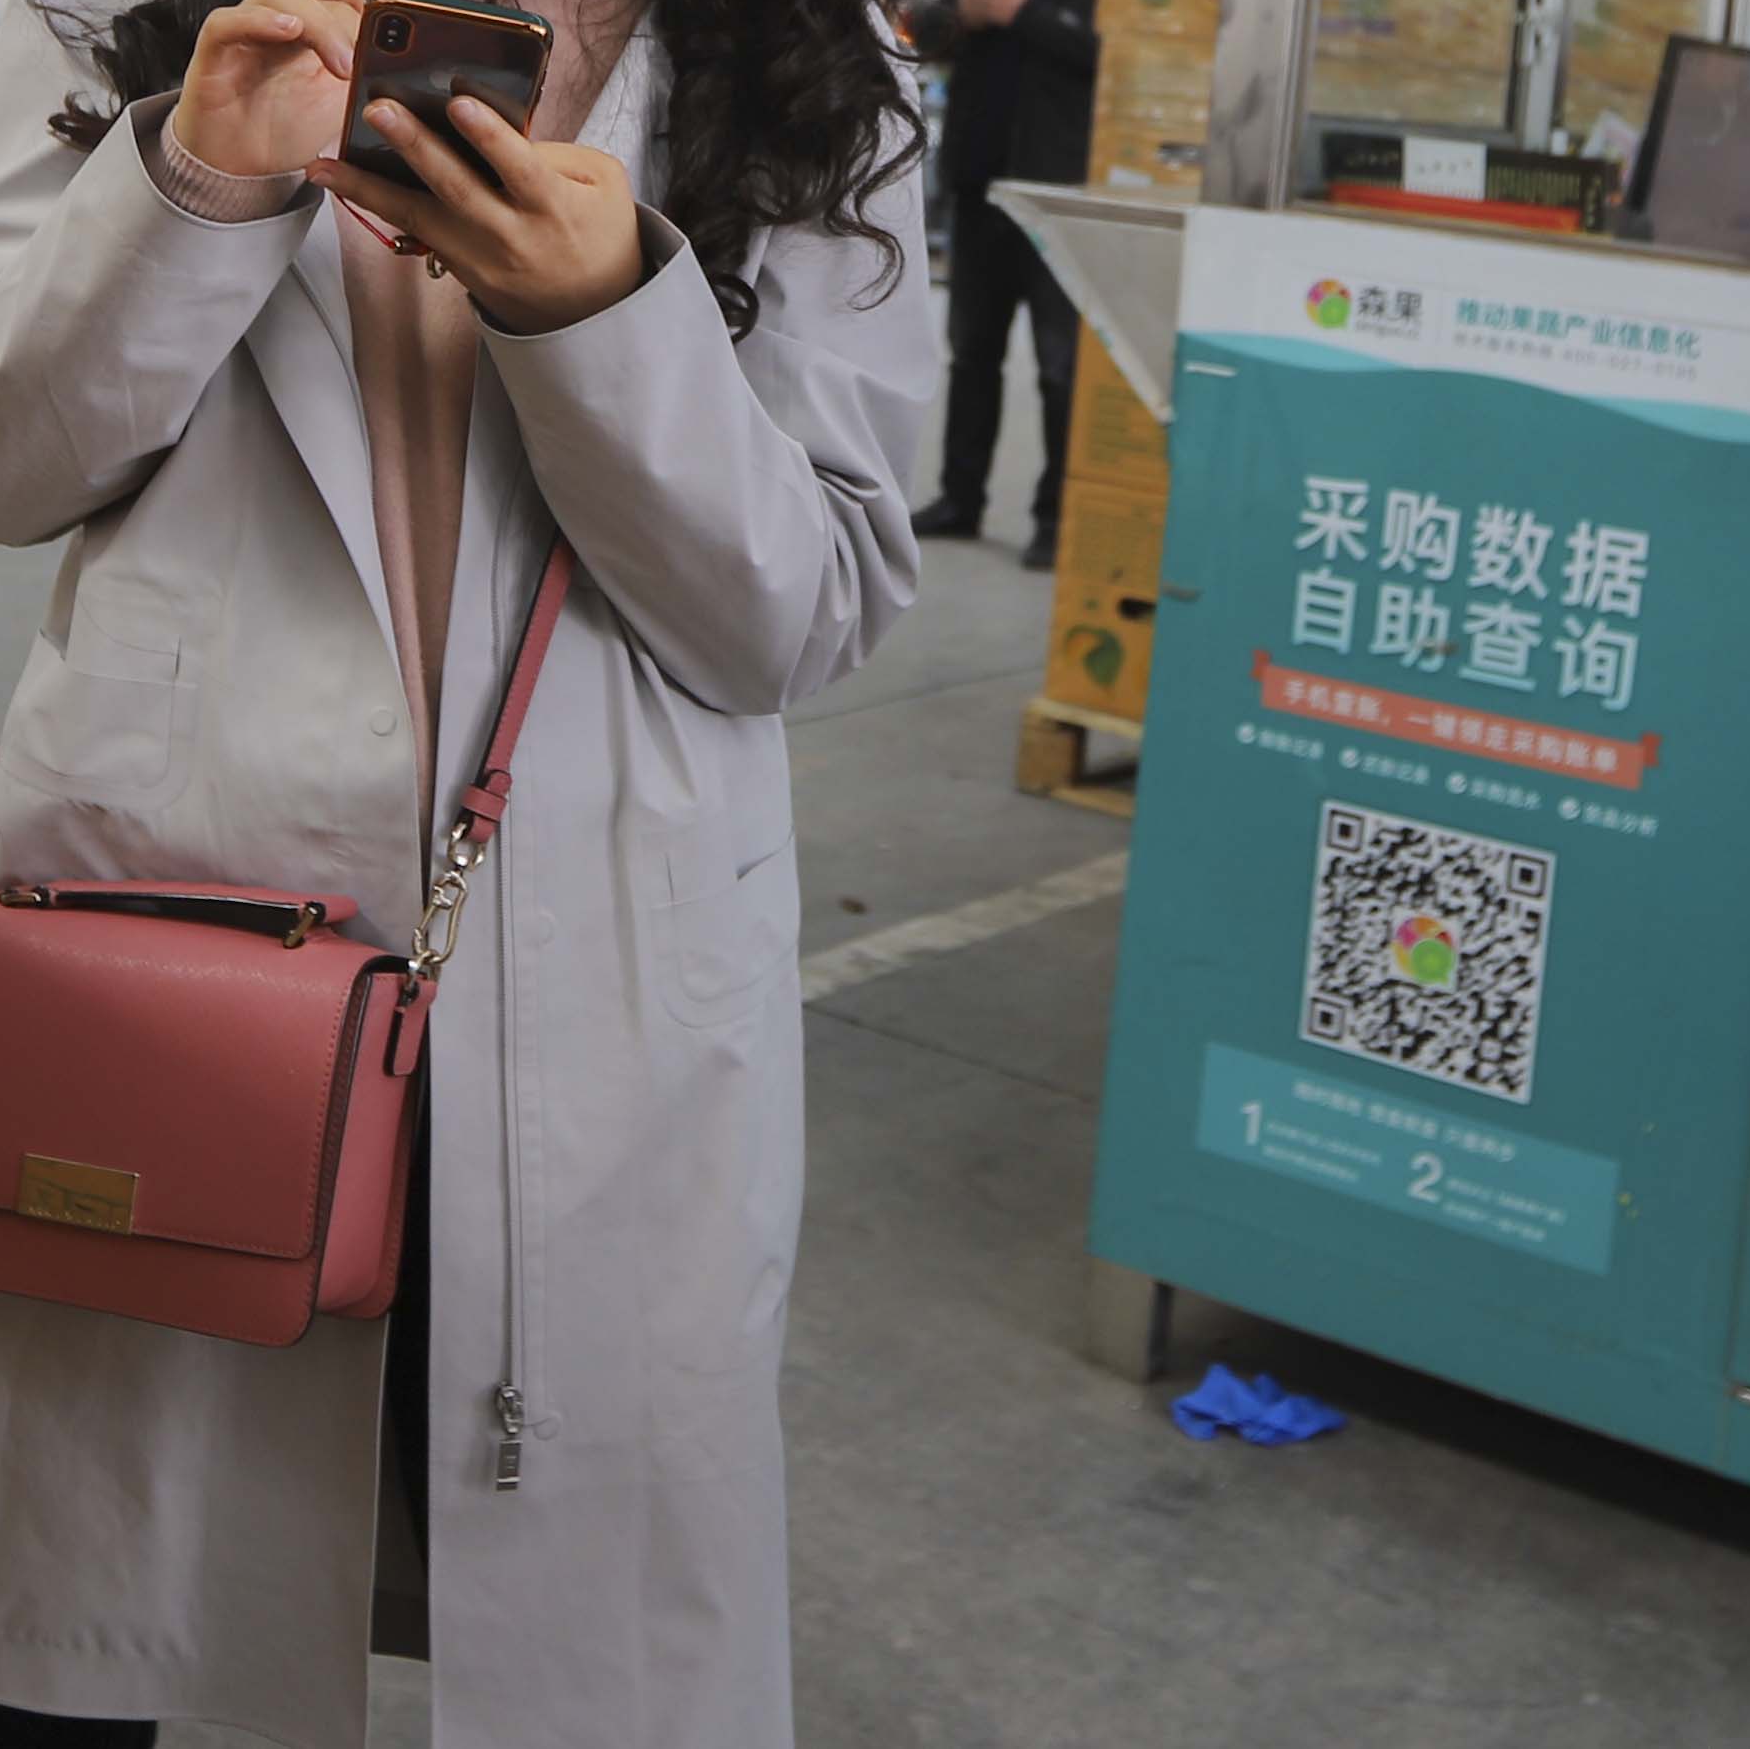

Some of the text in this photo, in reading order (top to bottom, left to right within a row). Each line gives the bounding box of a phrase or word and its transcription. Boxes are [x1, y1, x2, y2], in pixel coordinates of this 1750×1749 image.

[1357, 285, 1424, 323] 森果
[1295, 475, 1651, 619] 采购数据
[1290, 565, 1639, 712] 自助查询
